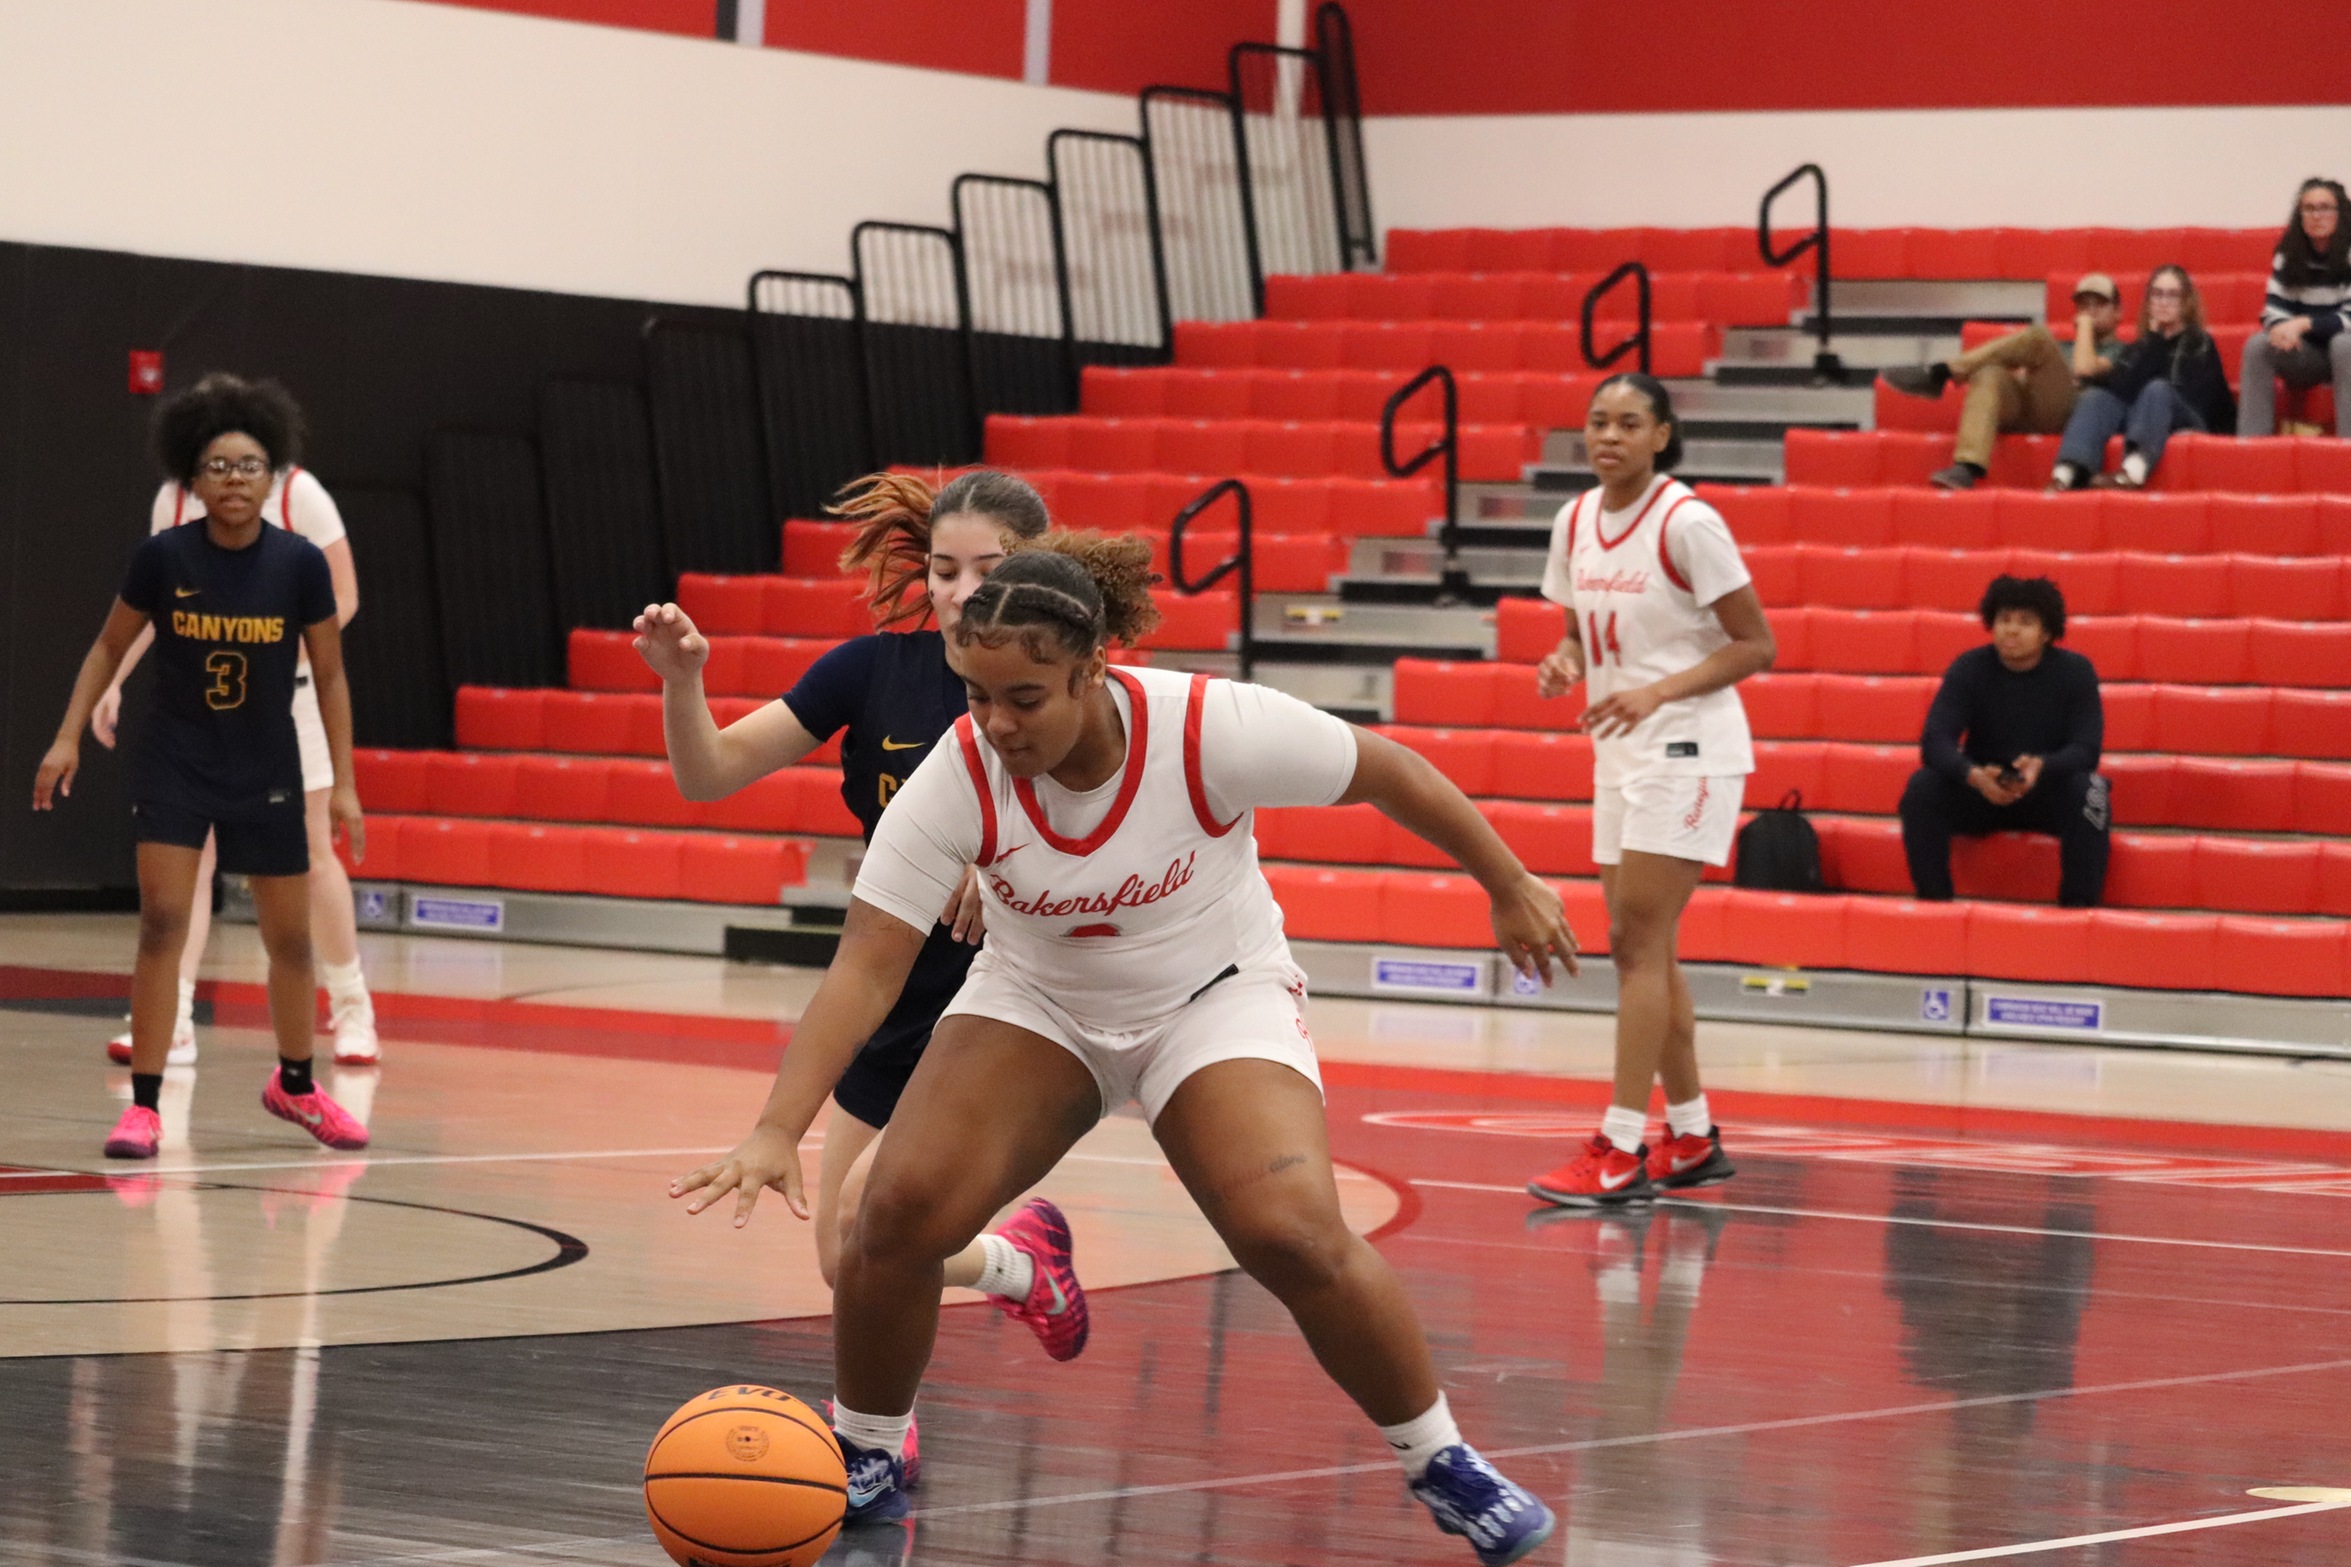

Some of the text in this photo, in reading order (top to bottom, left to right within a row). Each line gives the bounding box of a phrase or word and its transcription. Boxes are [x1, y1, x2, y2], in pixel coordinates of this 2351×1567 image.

[172, 610, 285, 643] CANYONS
[1588, 611, 1621, 667] 14
[206, 651, 247, 710] 3
[990, 850, 1196, 917] Bakersfield
